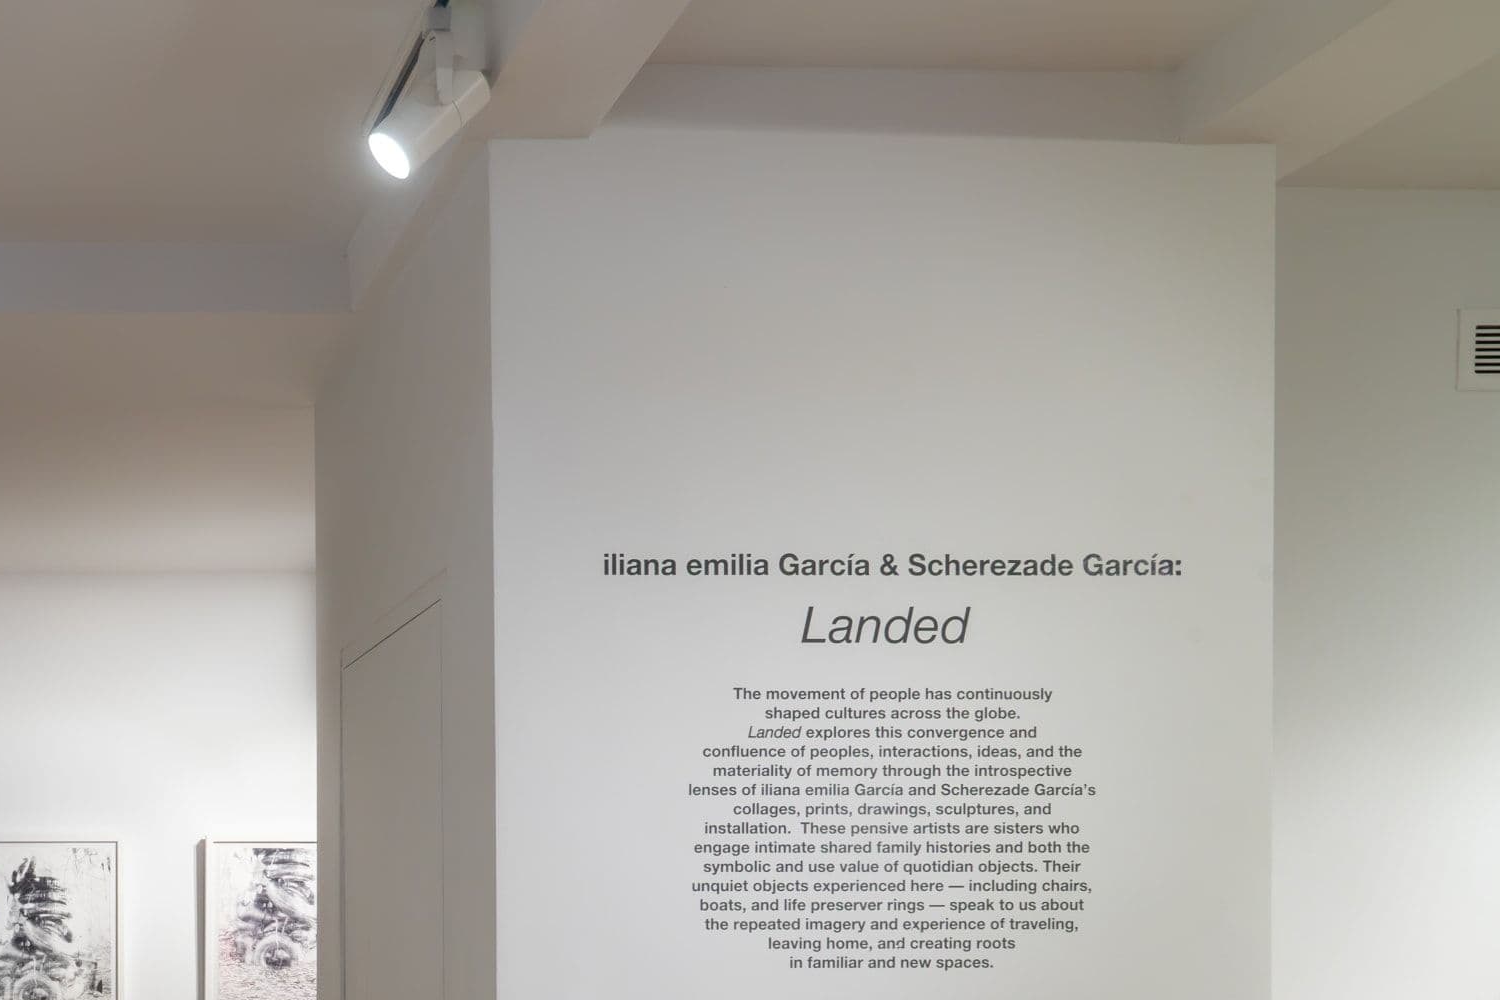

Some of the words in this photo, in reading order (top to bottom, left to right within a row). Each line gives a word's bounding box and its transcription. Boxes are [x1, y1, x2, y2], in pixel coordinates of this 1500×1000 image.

[603, 552, 677, 577] iliana
[685, 552, 770, 577] emilia
[778, 552, 871, 577] García
[879, 553, 900, 577] &
[907, 552, 1074, 577] Scherezade
[1082, 552, 1182, 577] García:
[800, 605, 972, 645] Landed
[732, 686, 762, 700] The
[765, 687, 847, 701] movement
[849, 687, 867, 701] of
[869, 687, 921, 703] people
[924, 687, 953, 701] has
[956, 687, 1053, 704] continuously
[764, 706, 821, 722] shaped
[824, 706, 887, 720] cultures
[890, 709, 942, 720] across
[945, 706, 970, 720] the
[974, 706, 1021, 723] globe.
[747, 725, 803, 739] Landed
[805, 725, 871, 742] explores
[874, 725, 903, 739] this
[906, 728, 1006, 742] convergence
[1008, 725, 1038, 739] and
[702, 744, 787, 758] confluence
[790, 744, 807, 758] of
[809, 744, 874, 761] peoples,
[878, 744, 973, 760] interactions,
[976, 744, 1022, 760] ideas,
[1025, 744, 1054, 758] and
[1057, 744, 1083, 758] the
[712, 763, 793, 780] materiality
[796, 764, 813, 777] of
[816, 766, 879, 780] memory
[881, 763, 942, 780] through
[945, 763, 971, 777] the
[974, 763, 1073, 780] introspective
[688, 783, 738, 797] lenses
[741, 783, 757, 796] of
[760, 783, 801, 797] iliana
[804, 783, 850, 797] emilia
[854, 782, 904, 797] García
[907, 783, 937, 797] and
[940, 782, 1030, 797] Scherezade
[732, 802, 801, 819] collages,
[805, 802, 853, 818] prints,
[857, 802, 931, 819] drawings,
[934, 802, 1019, 818] sculptures,
[1023, 802, 1052, 816] and
[704, 821, 792, 835] installation.
[799, 821, 847, 835] These
[850, 821, 909, 838] pensive
[912, 821, 961, 835] artists
[964, 824, 990, 835] are
[993, 821, 1044, 835] sisters
[1047, 821, 1081, 835] who
[693, 843, 751, 857] engage
[754, 840, 816, 854] intimate
[820, 840, 872, 854] shared
[876, 840, 922, 857] family
[925, 840, 992, 854] histories
[995, 840, 1024, 854] and
[1027, 840, 1062, 854] both
[1065, 840, 1091, 854] the
[702, 859, 772, 876] symbolic
[775, 859, 804, 873] and
[808, 862, 836, 873] use
[839, 859, 880, 873] value
[883, 859, 900, 873] of
[902, 859, 974, 876] quotidian
[977, 859, 1038, 876] objects.
[1041, 859, 1082, 873] Their
[691, 879, 749, 895] unquiet
[752, 879, 809, 895] objects
[812, 879, 906, 895] experienced
[910, 879, 945, 892] here
[968, 878, 1038, 895] including
[1041, 878, 1093, 894] chairs,
[699, 898, 747, 914] boats,
[750, 898, 780, 912] and
[783, 898, 807, 912] life
[810, 901, 884, 914] preserver
[886, 898, 925, 914] rings
[949, 898, 995, 914] speak
[998, 898, 1015, 911] to
[1018, 901, 1037, 912] us
[1040, 898, 1085, 912] about
[704, 917, 729, 931] the
[733, 917, 801, 934] repeated
[805, 917, 867, 934] imagery
[869, 917, 899, 931] and
[902, 917, 986, 934] experience
[989, 917, 1006, 931] of
[1008, 917, 1079, 934] traveling,
[768, 936, 822, 953] leaving
[826, 936, 873, 952] home,
[877, 936, 906, 950] and
[909, 936, 972, 953] creating
[976, 937, 1016, 950] roots
[789, 955, 803, 969] in
[806, 955, 865, 969] familiar
[867, 955, 896, 969] and
[900, 958, 932, 969] new
[935, 958, 994, 972] spaces.
